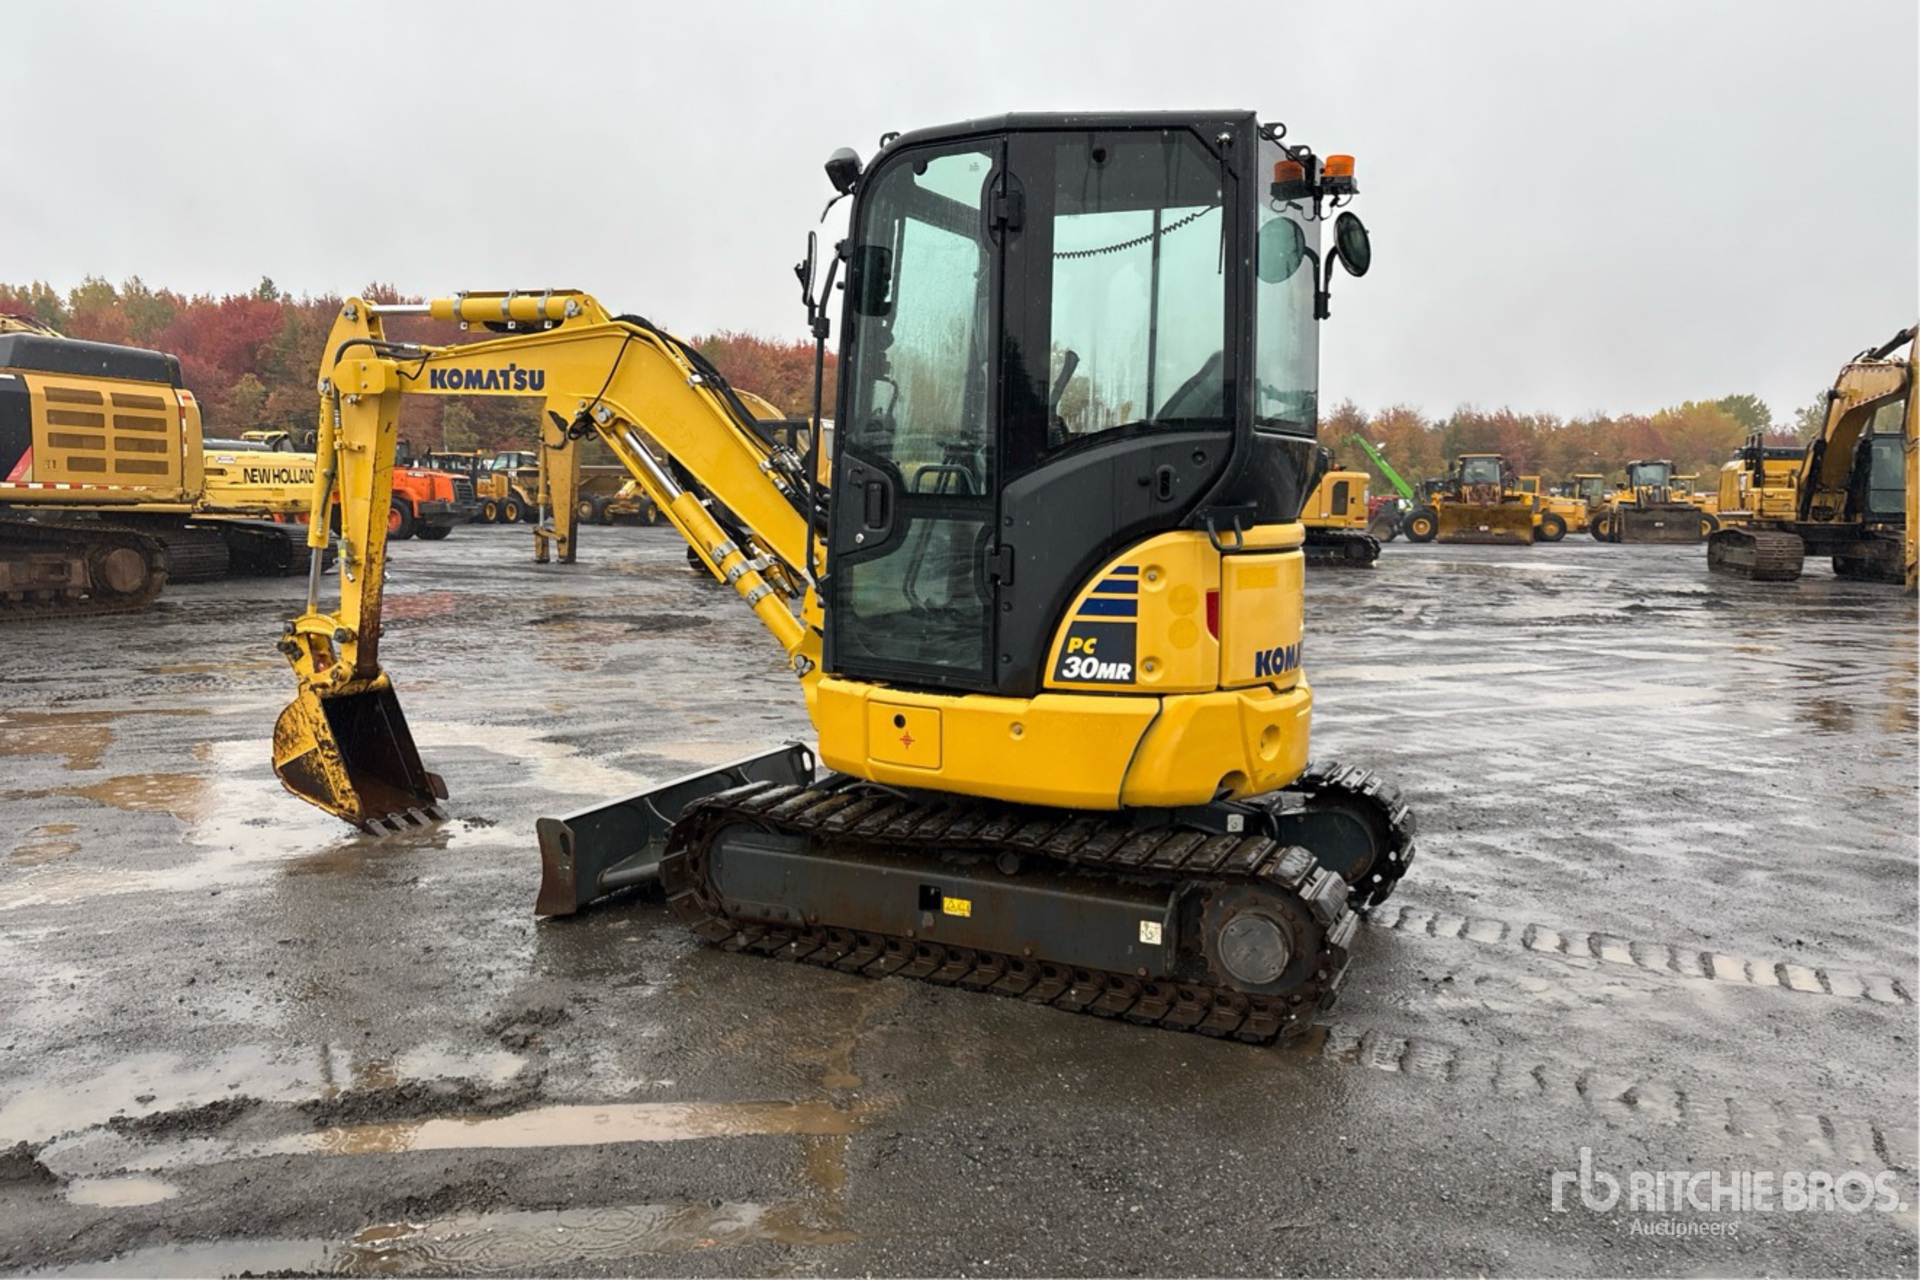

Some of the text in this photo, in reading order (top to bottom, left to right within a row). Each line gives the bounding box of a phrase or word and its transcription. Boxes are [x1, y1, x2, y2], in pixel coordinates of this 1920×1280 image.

[430, 363, 545, 391] KOMATSU
[243, 468, 315, 484] NEW HOLLAND
[1067, 637, 1098, 655] PC
[1061, 656, 1132, 680] 30MR
